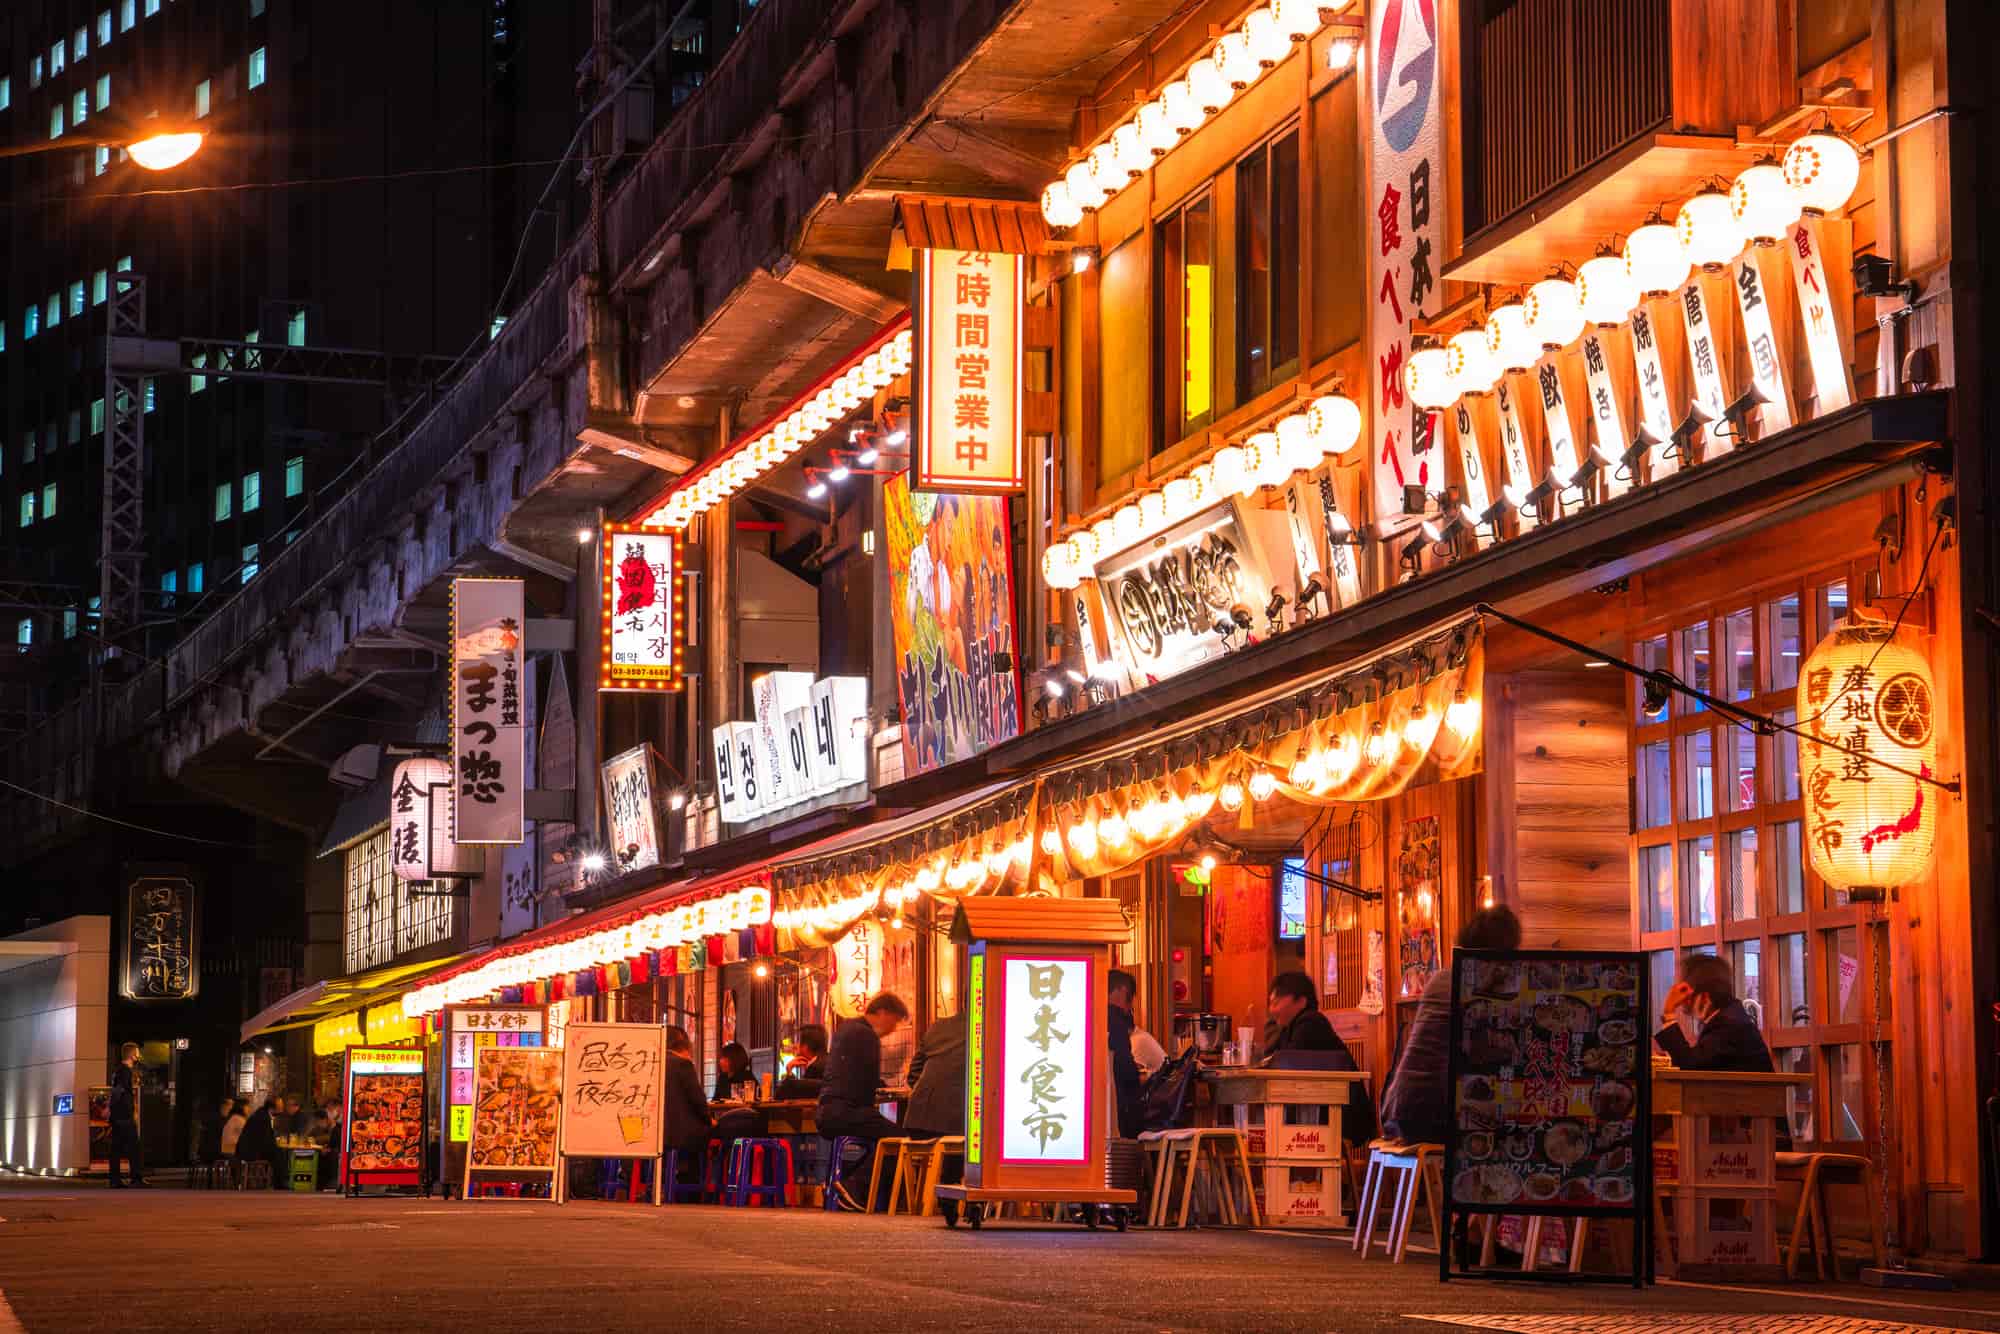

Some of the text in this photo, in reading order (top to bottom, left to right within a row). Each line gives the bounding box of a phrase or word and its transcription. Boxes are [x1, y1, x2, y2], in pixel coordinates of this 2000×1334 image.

[1410, 158, 1434, 456] 日本国
[955, 251, 991, 471] 24時間営業中
[1287, 486, 1309, 580] ラーメ
[648, 563, 669, 659] 한식시장
[460, 662, 505, 804] まつ惣
[1807, 665, 1845, 863] 日本食市
[1840, 664, 1875, 783] 産地直送
[850, 923, 870, 1012] 한식시장
[466, 1013, 528, 1029] 日本食市
[577, 1042, 660, 1075] 昼呑み
[1020, 962, 1071, 1157] 日本食市
[575, 1079, 653, 1106] 夜呑み
[1291, 1131, 1319, 1143] Asahi
[1291, 1197, 1319, 1209] Asahi
[1713, 1152, 1748, 1167] Asahi
